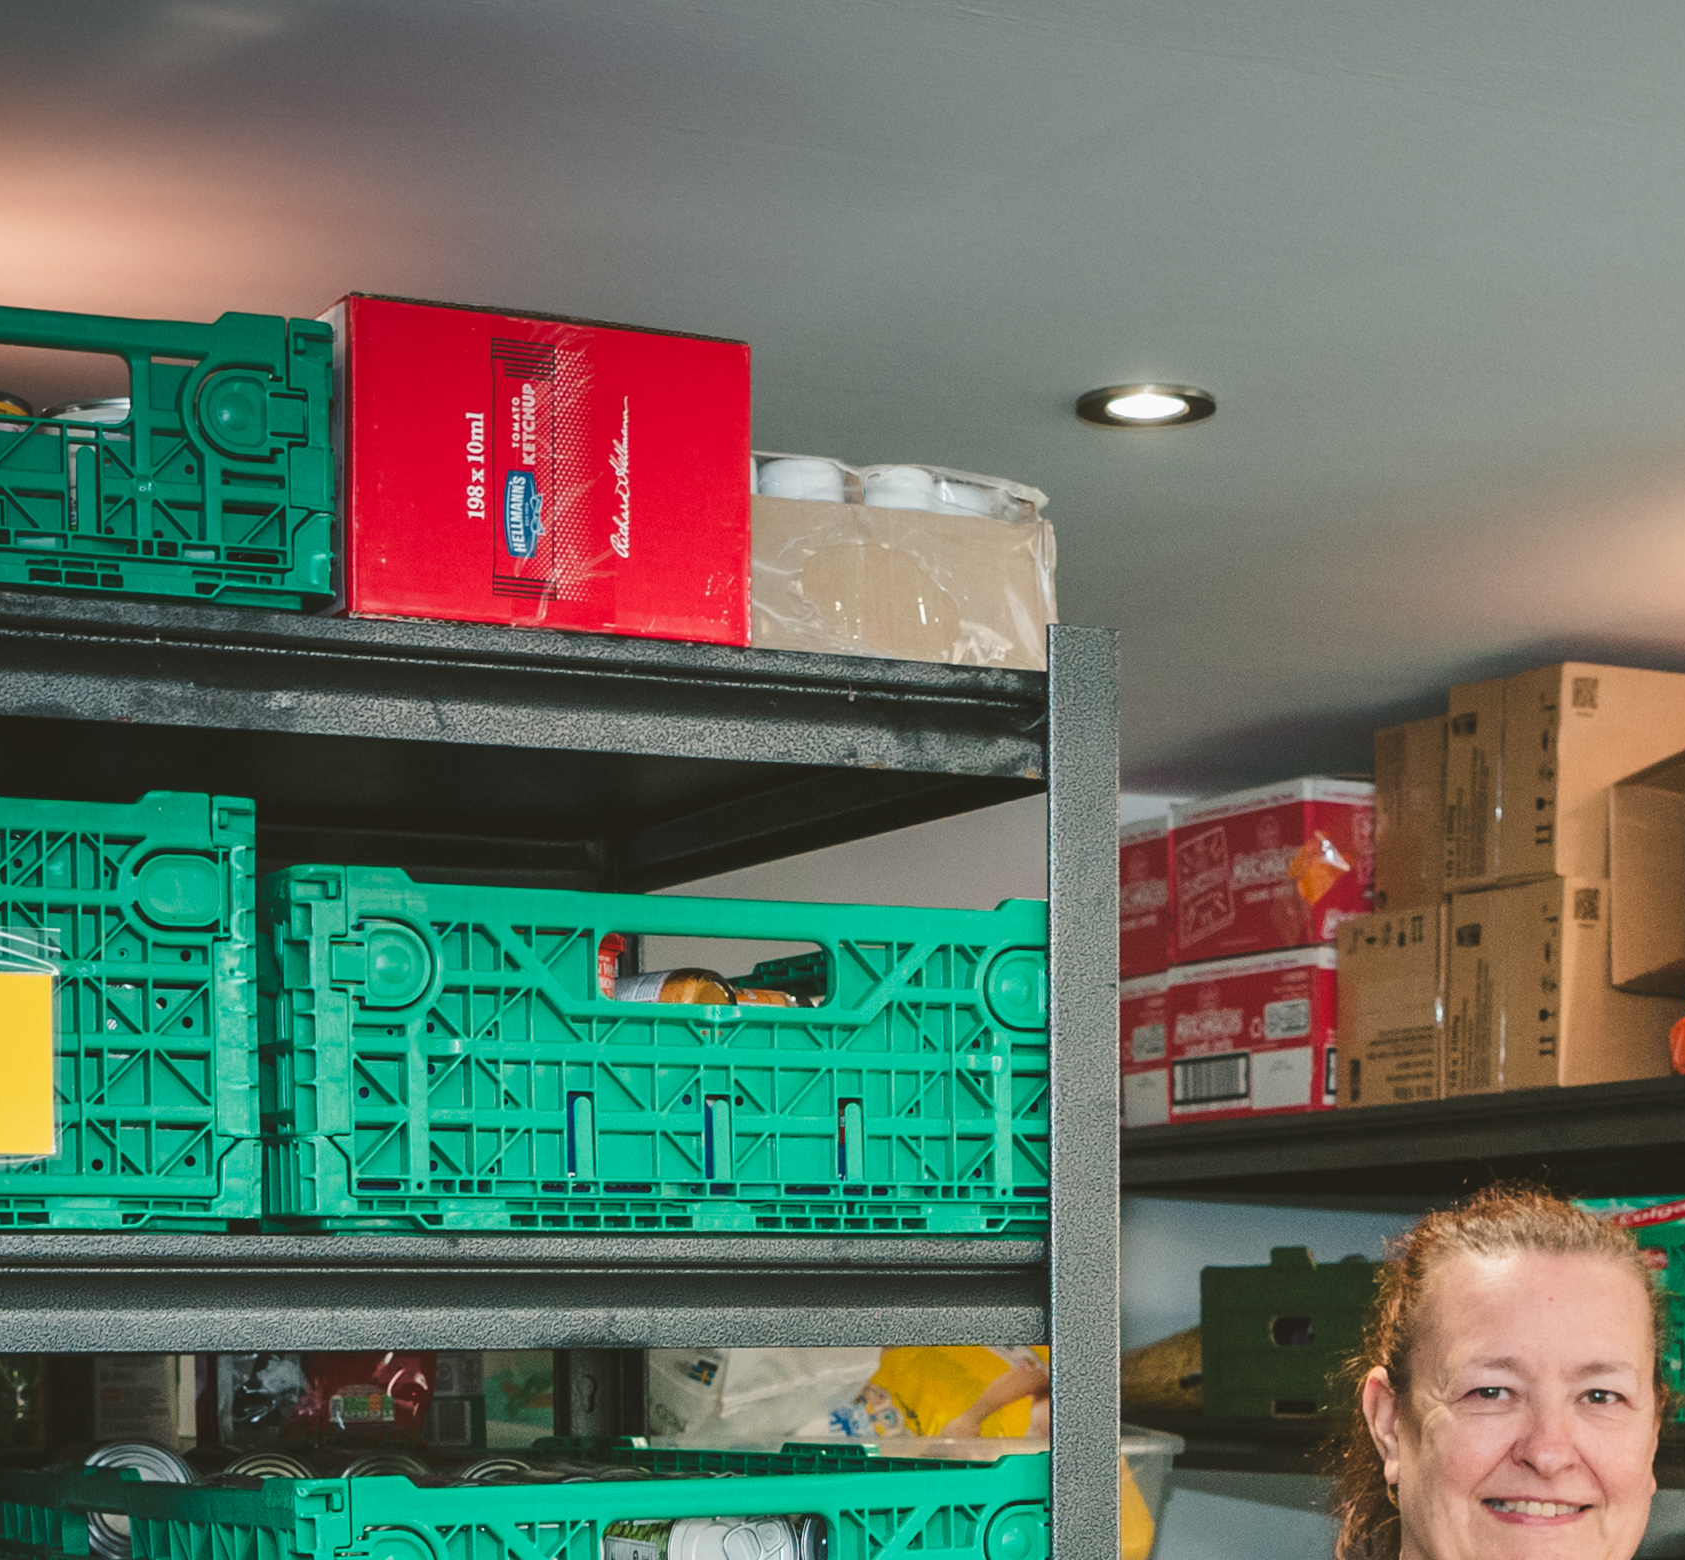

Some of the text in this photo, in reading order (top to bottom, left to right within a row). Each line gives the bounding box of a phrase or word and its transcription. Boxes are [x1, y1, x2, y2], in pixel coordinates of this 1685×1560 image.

[511, 396, 521, 449] TOMATO
[521, 383, 537, 466] KETCHUP
[465, 412, 486, 520] 198 x 10ml
[508, 475, 527, 553] HELLMANN'S
